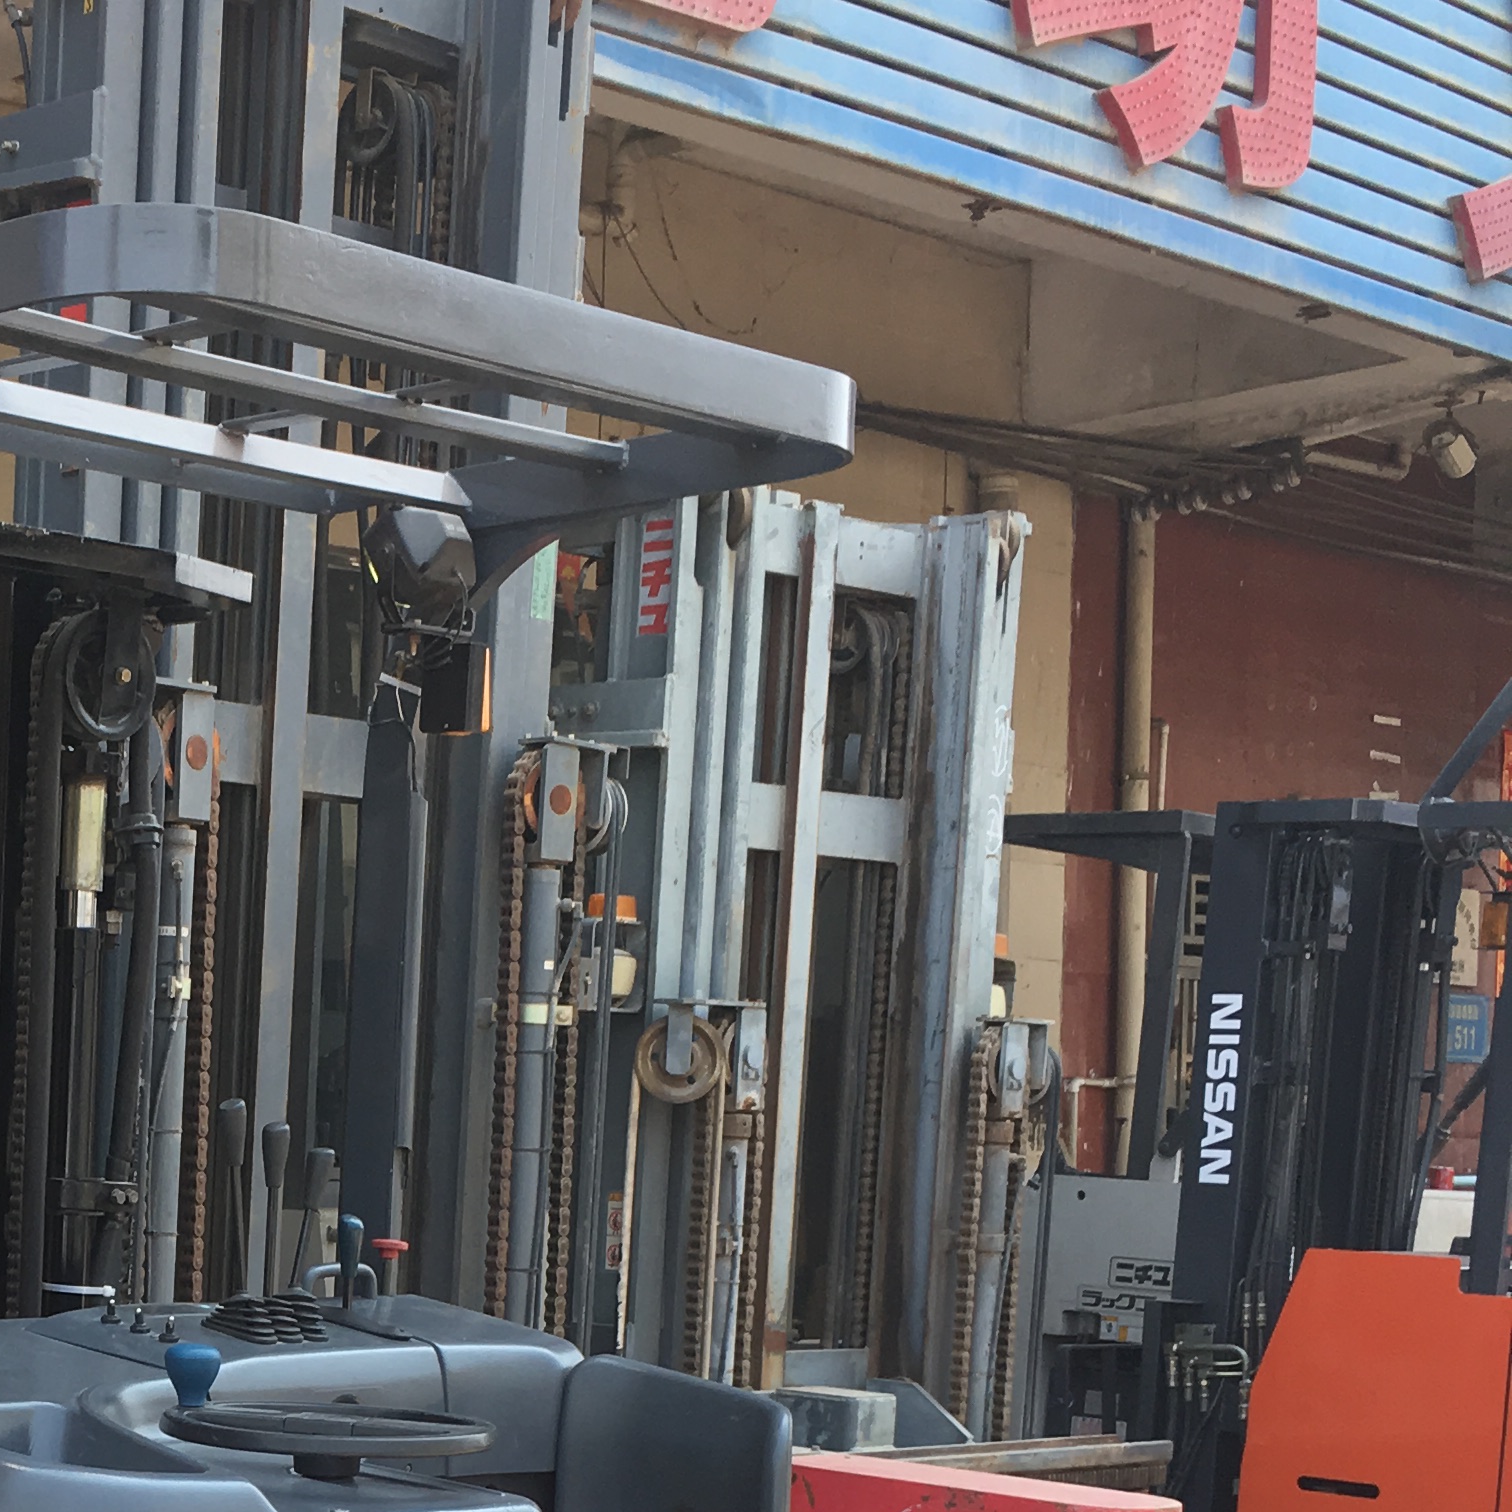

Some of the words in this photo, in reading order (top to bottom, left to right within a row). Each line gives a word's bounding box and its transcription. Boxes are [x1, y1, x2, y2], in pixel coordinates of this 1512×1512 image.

[639, 519, 674, 636] ニチユ
[1199, 993, 1244, 1185] NISSAN
[1454, 1024, 1476, 1050] 511
